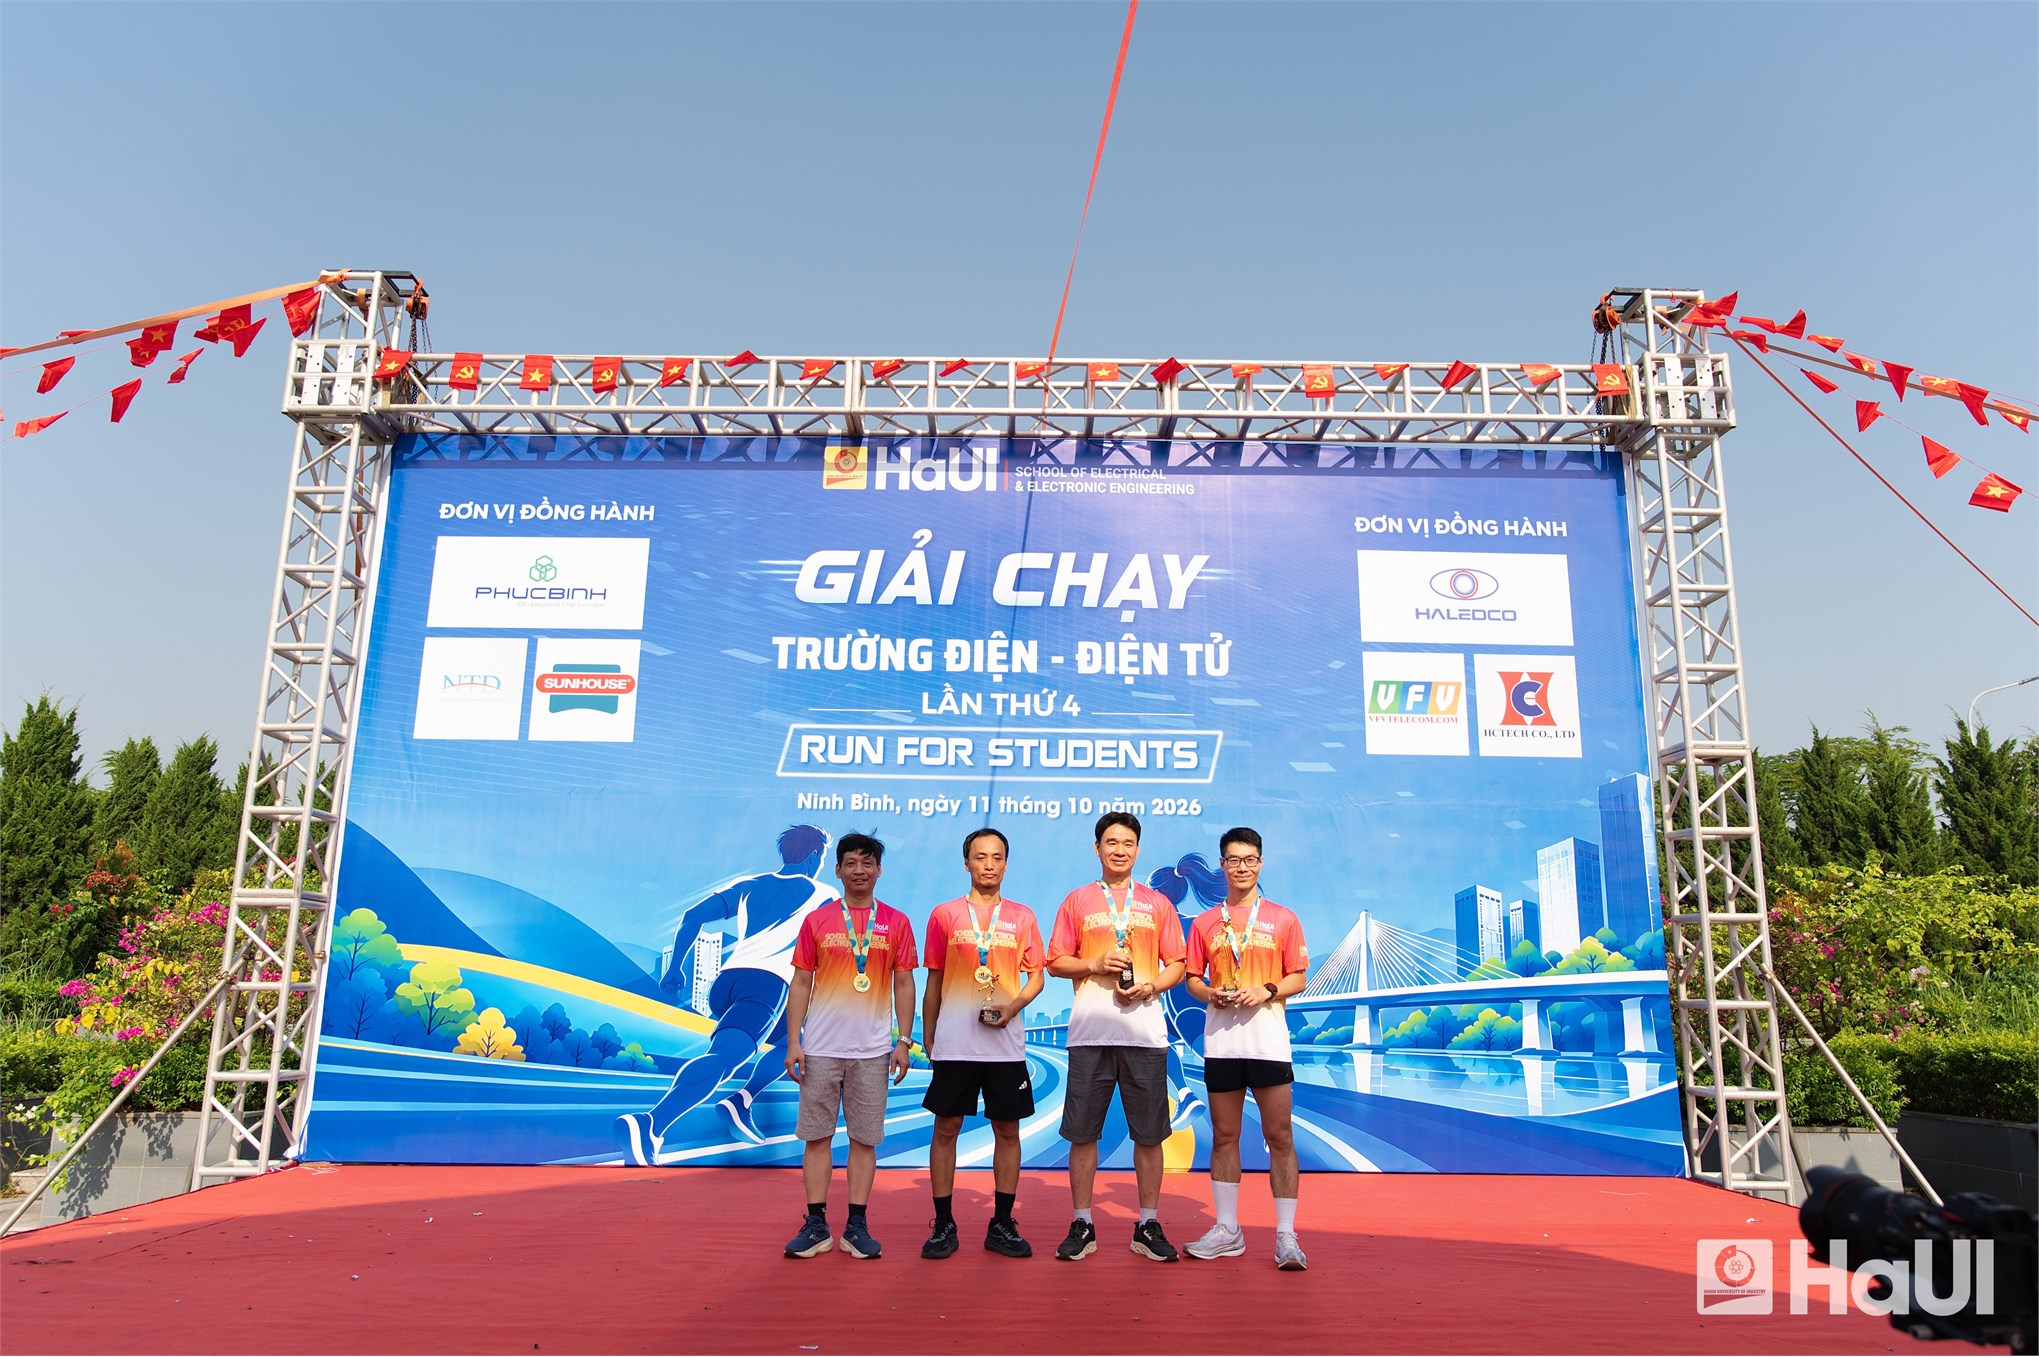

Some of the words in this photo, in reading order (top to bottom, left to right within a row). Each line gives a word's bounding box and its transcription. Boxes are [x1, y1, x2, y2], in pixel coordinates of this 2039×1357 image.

[1015, 466, 1067, 478] SCHOOL
[1070, 467, 1087, 478] OF
[1090, 467, 1167, 480] ELECTRICAL
[1015, 481, 1024, 492] &
[1027, 481, 1106, 493] ELECTRONIC
[1109, 482, 1195, 495] ENGINEERING
[439, 501, 489, 520] ĐƠN
[493, 503, 515, 524] VỊ
[520, 496, 585, 521] ĐỒNG
[590, 501, 655, 521] HÀNH
[1354, 515, 1403, 533] ĐƠN
[1407, 518, 1430, 538] VỊ
[1434, 511, 1499, 536] ĐỒNG
[1504, 517, 1568, 537] HÀNH
[795, 528, 966, 606] GIẢI
[992, 551, 1210, 623] CHẠY
[1415, 608, 1517, 622] HALEDCO
[772, 629, 933, 672] TRƯỜNG
[944, 630, 1038, 682] ĐIỆN
[1076, 633, 1168, 684] ĐIỆN
[1180, 632, 1233, 677] TỬ
[921, 682, 983, 716] LẦN
[990, 689, 1057, 717] THỨ
[1062, 693, 1081, 717] 4
[1368, 715, 1458, 724] VFVTELECOM.COM
[1484, 729, 1529, 738] HCTECH
[1555, 731, 1575, 739] LTD
[800, 735, 884, 765] RUN
[897, 737, 974, 767] FOR
[988, 739, 1198, 769] STUDENTS
[797, 792, 847, 810] Ninh
[850, 793, 901, 814] Bình,
[908, 794, 961, 818] ngày
[968, 796, 990, 813] 11
[998, 796, 1061, 817] tháng
[1068, 797, 1093, 815] 10
[1099, 795, 1146, 815] năm
[1151, 798, 1202, 816] 2026
